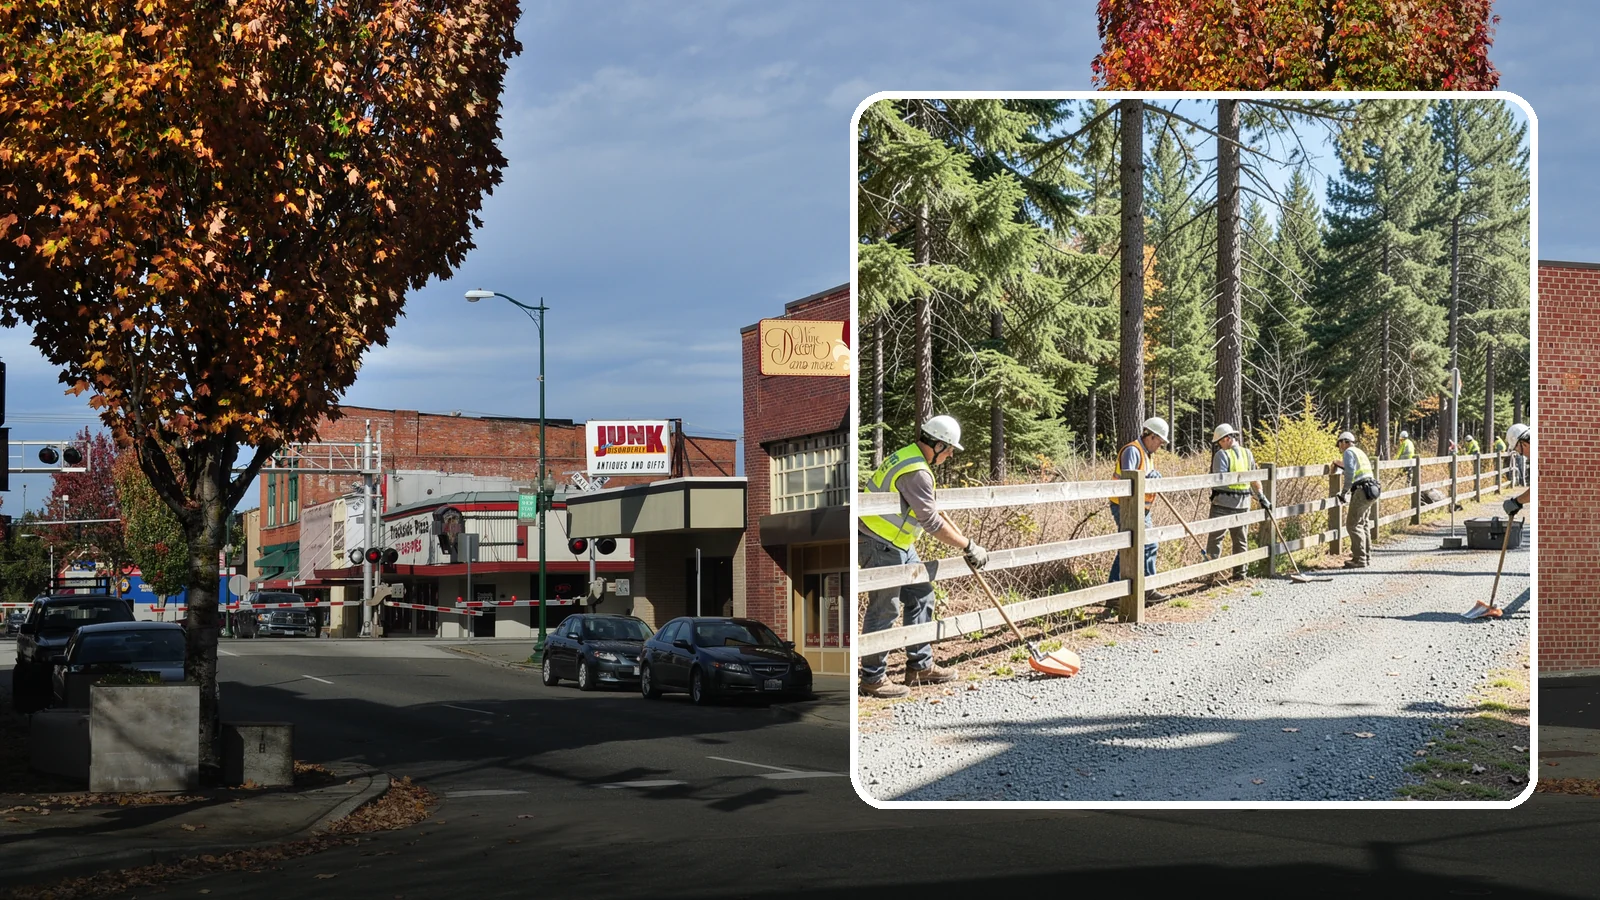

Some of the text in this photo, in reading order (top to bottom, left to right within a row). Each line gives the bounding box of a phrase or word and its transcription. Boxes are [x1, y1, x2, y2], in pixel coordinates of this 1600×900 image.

[765, 328, 831, 365] Decor
[595, 425, 665, 457] JUNK
[607, 446, 646, 454] DISORDERLY
[596, 460, 665, 470] ANTIQUES AND GIFTS
[573, 473, 589, 493] RAIL
[390, 519, 429, 539] Trackside Pizza
